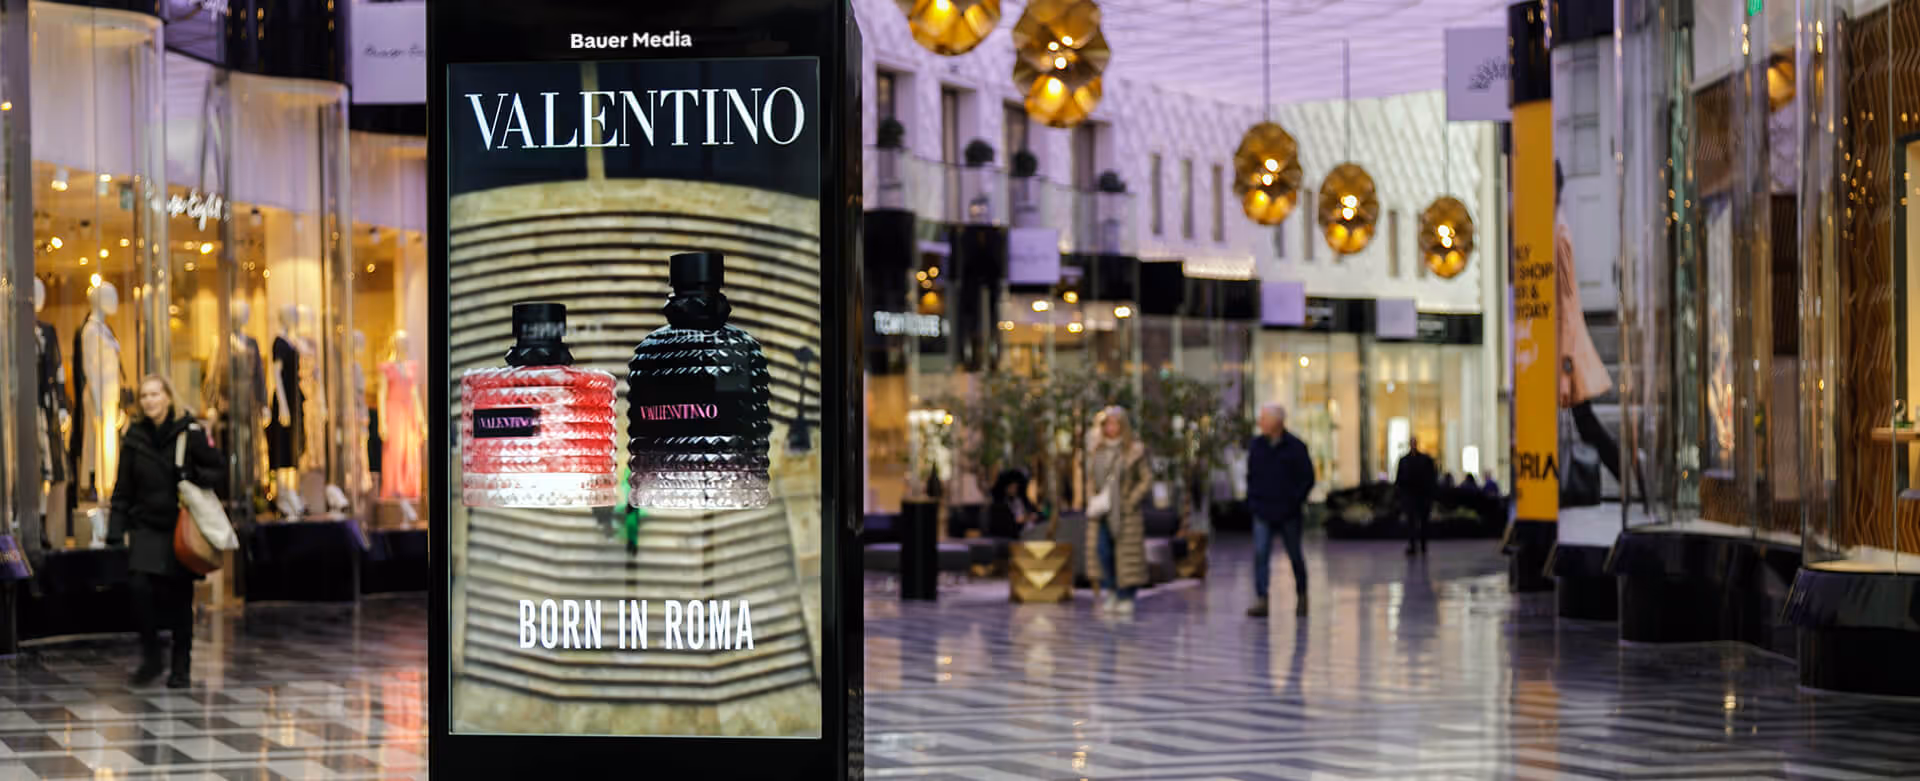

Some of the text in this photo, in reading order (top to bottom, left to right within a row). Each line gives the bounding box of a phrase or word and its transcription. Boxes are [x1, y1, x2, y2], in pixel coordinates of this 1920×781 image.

[570, 30, 692, 49] Bauer Media
[464, 86, 806, 151] VALENTINO
[640, 403, 718, 420] VALENTINO
[518, 598, 755, 650] BORN IN ROMA
